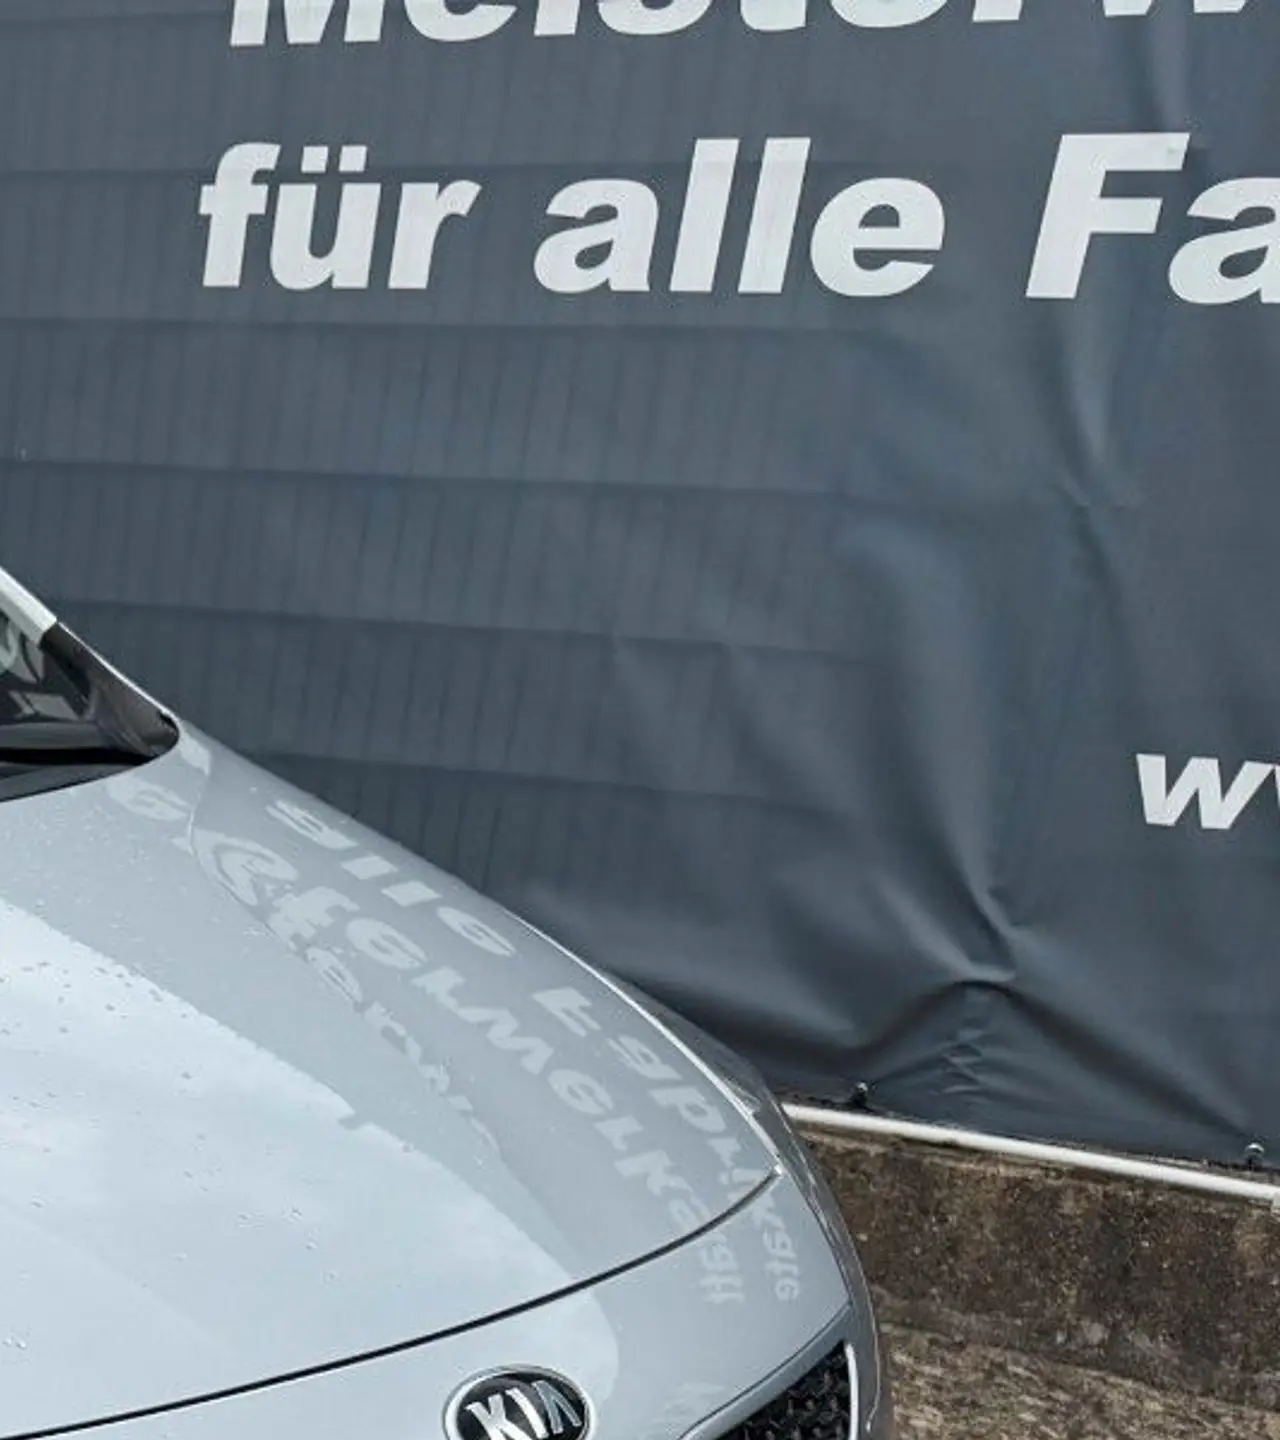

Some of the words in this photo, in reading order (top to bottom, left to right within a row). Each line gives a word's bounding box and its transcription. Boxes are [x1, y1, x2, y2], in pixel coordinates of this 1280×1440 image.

[199, 141, 482, 290] für
[533, 137, 945, 298] alle
[1026, 132, 1280, 304] Fa
[1136, 753, 1280, 829] w
